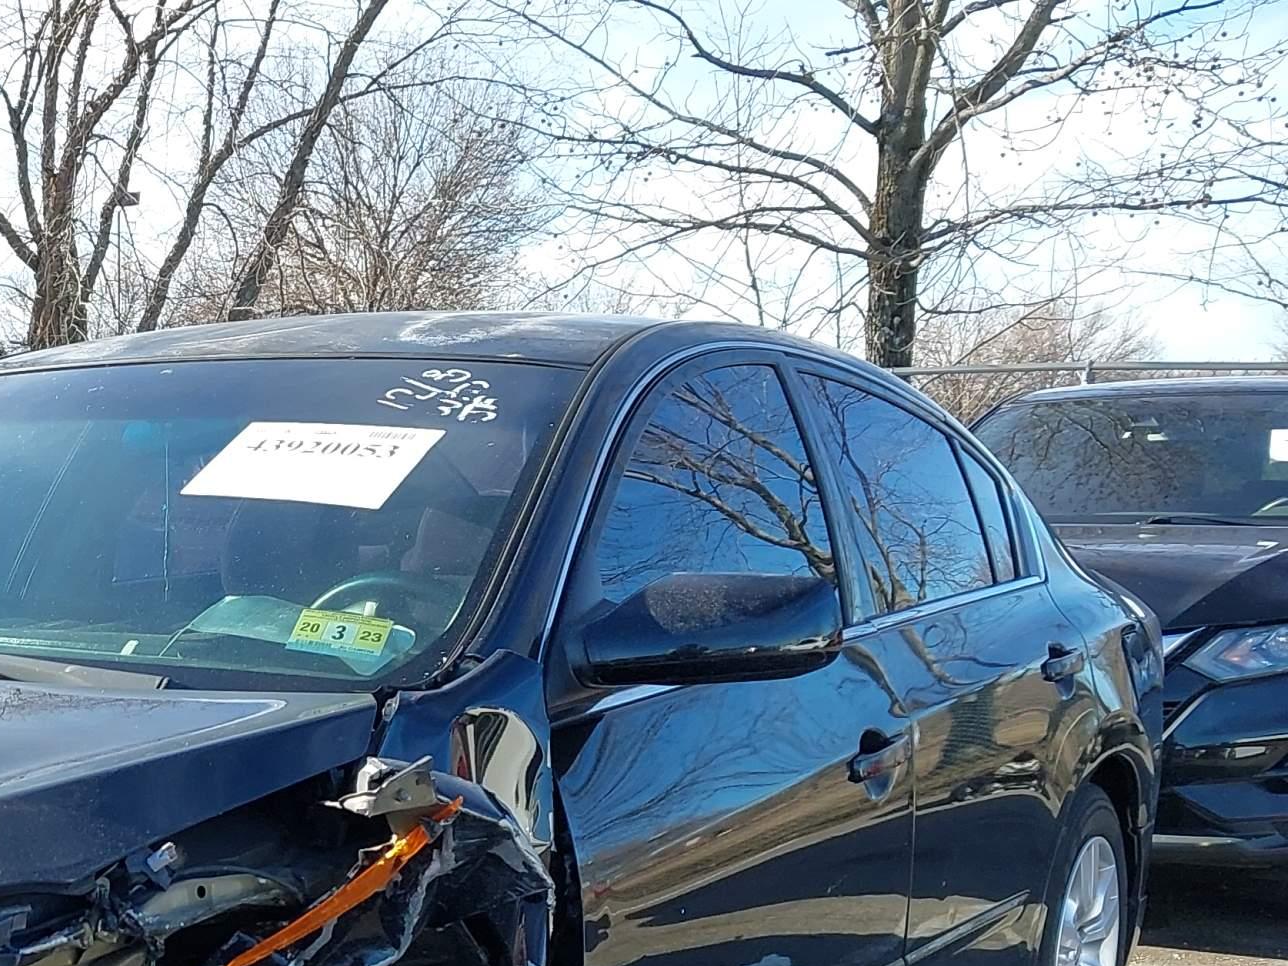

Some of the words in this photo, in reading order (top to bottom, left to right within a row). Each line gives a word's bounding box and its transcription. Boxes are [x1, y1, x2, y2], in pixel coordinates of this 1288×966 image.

[247, 439, 400, 458] 43920053
[299, 622, 321, 633] 20
[332, 625, 347, 640] 3
[359, 630, 383, 643] 23
